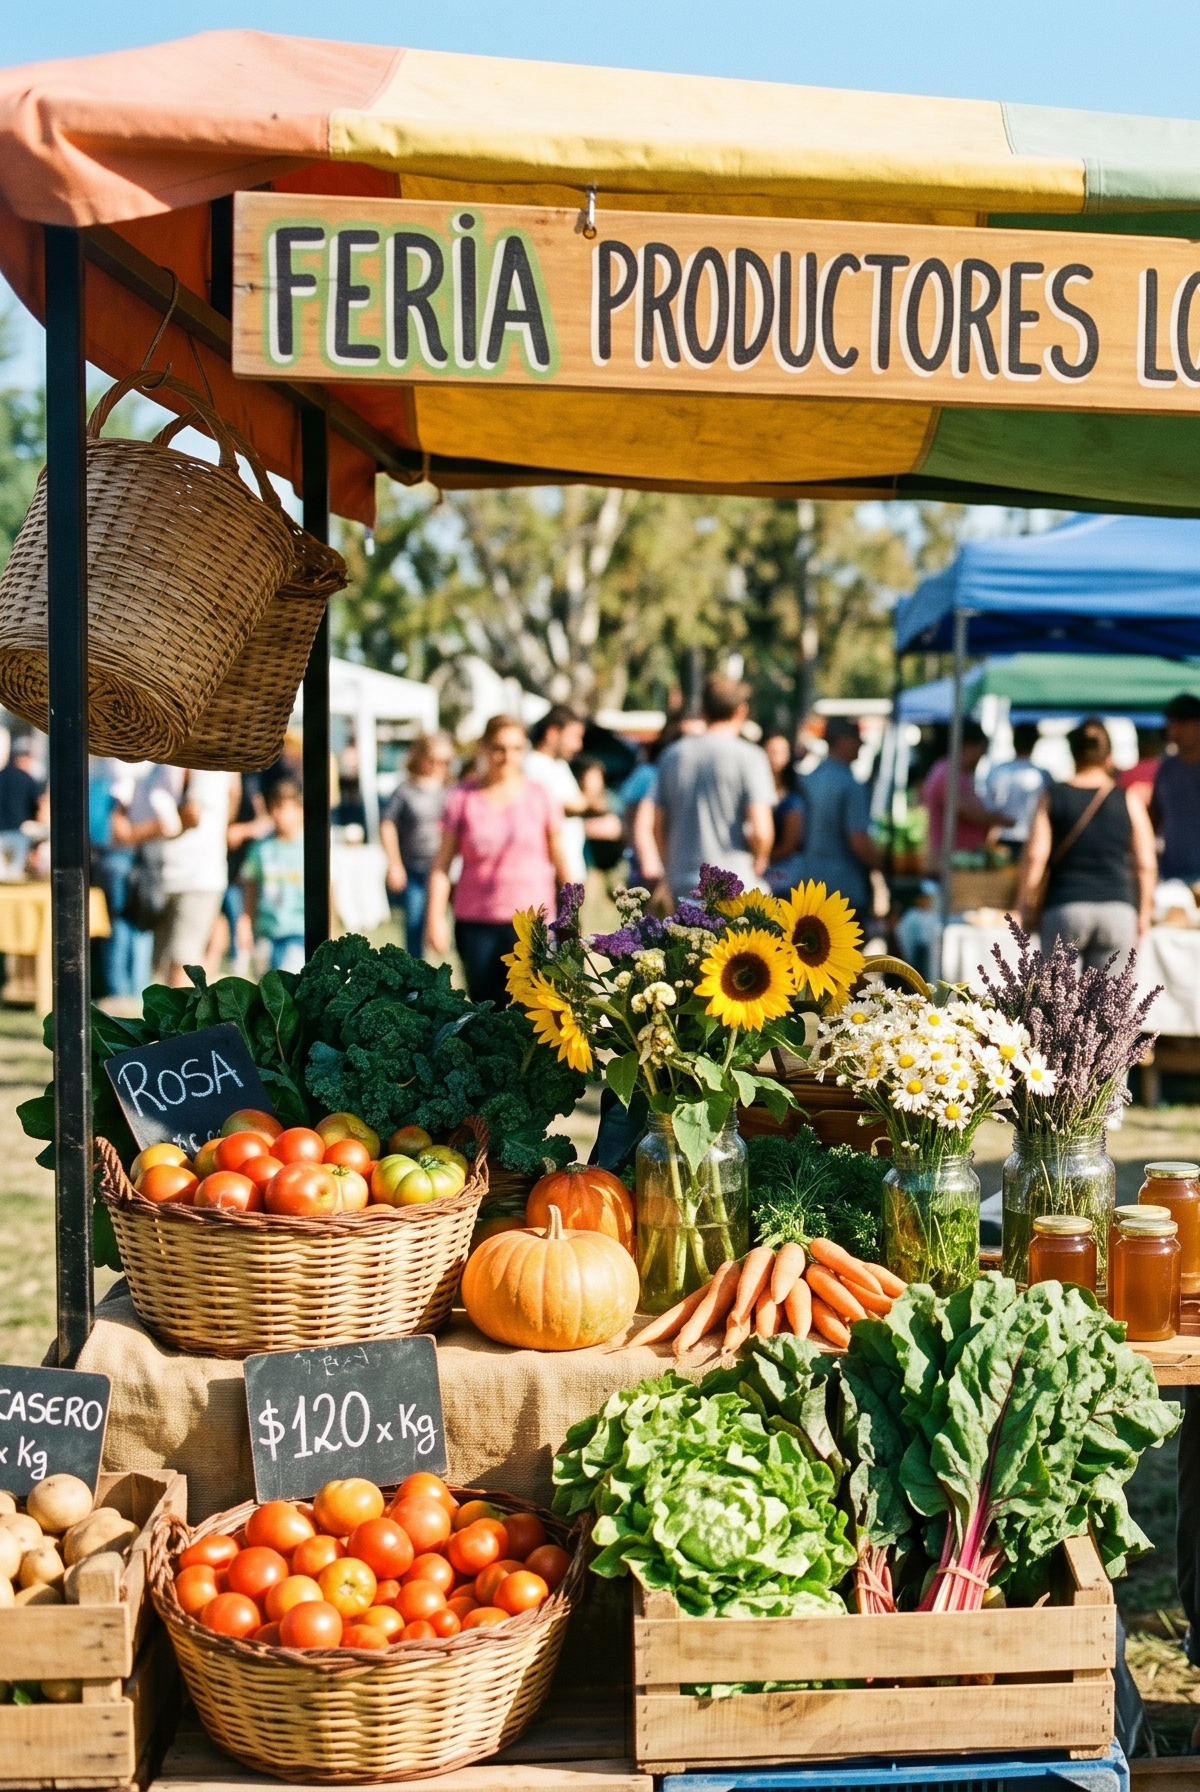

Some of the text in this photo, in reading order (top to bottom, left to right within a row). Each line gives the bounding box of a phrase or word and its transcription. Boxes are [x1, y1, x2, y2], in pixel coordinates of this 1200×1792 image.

[594, 240, 1099, 380] PRODUCTORES
[117, 1050, 245, 1118] ROSA
[17, 1436, 47, 1480] Kg
[258, 1391, 371, 1461] $120
[398, 1403, 438, 1454] Kg
